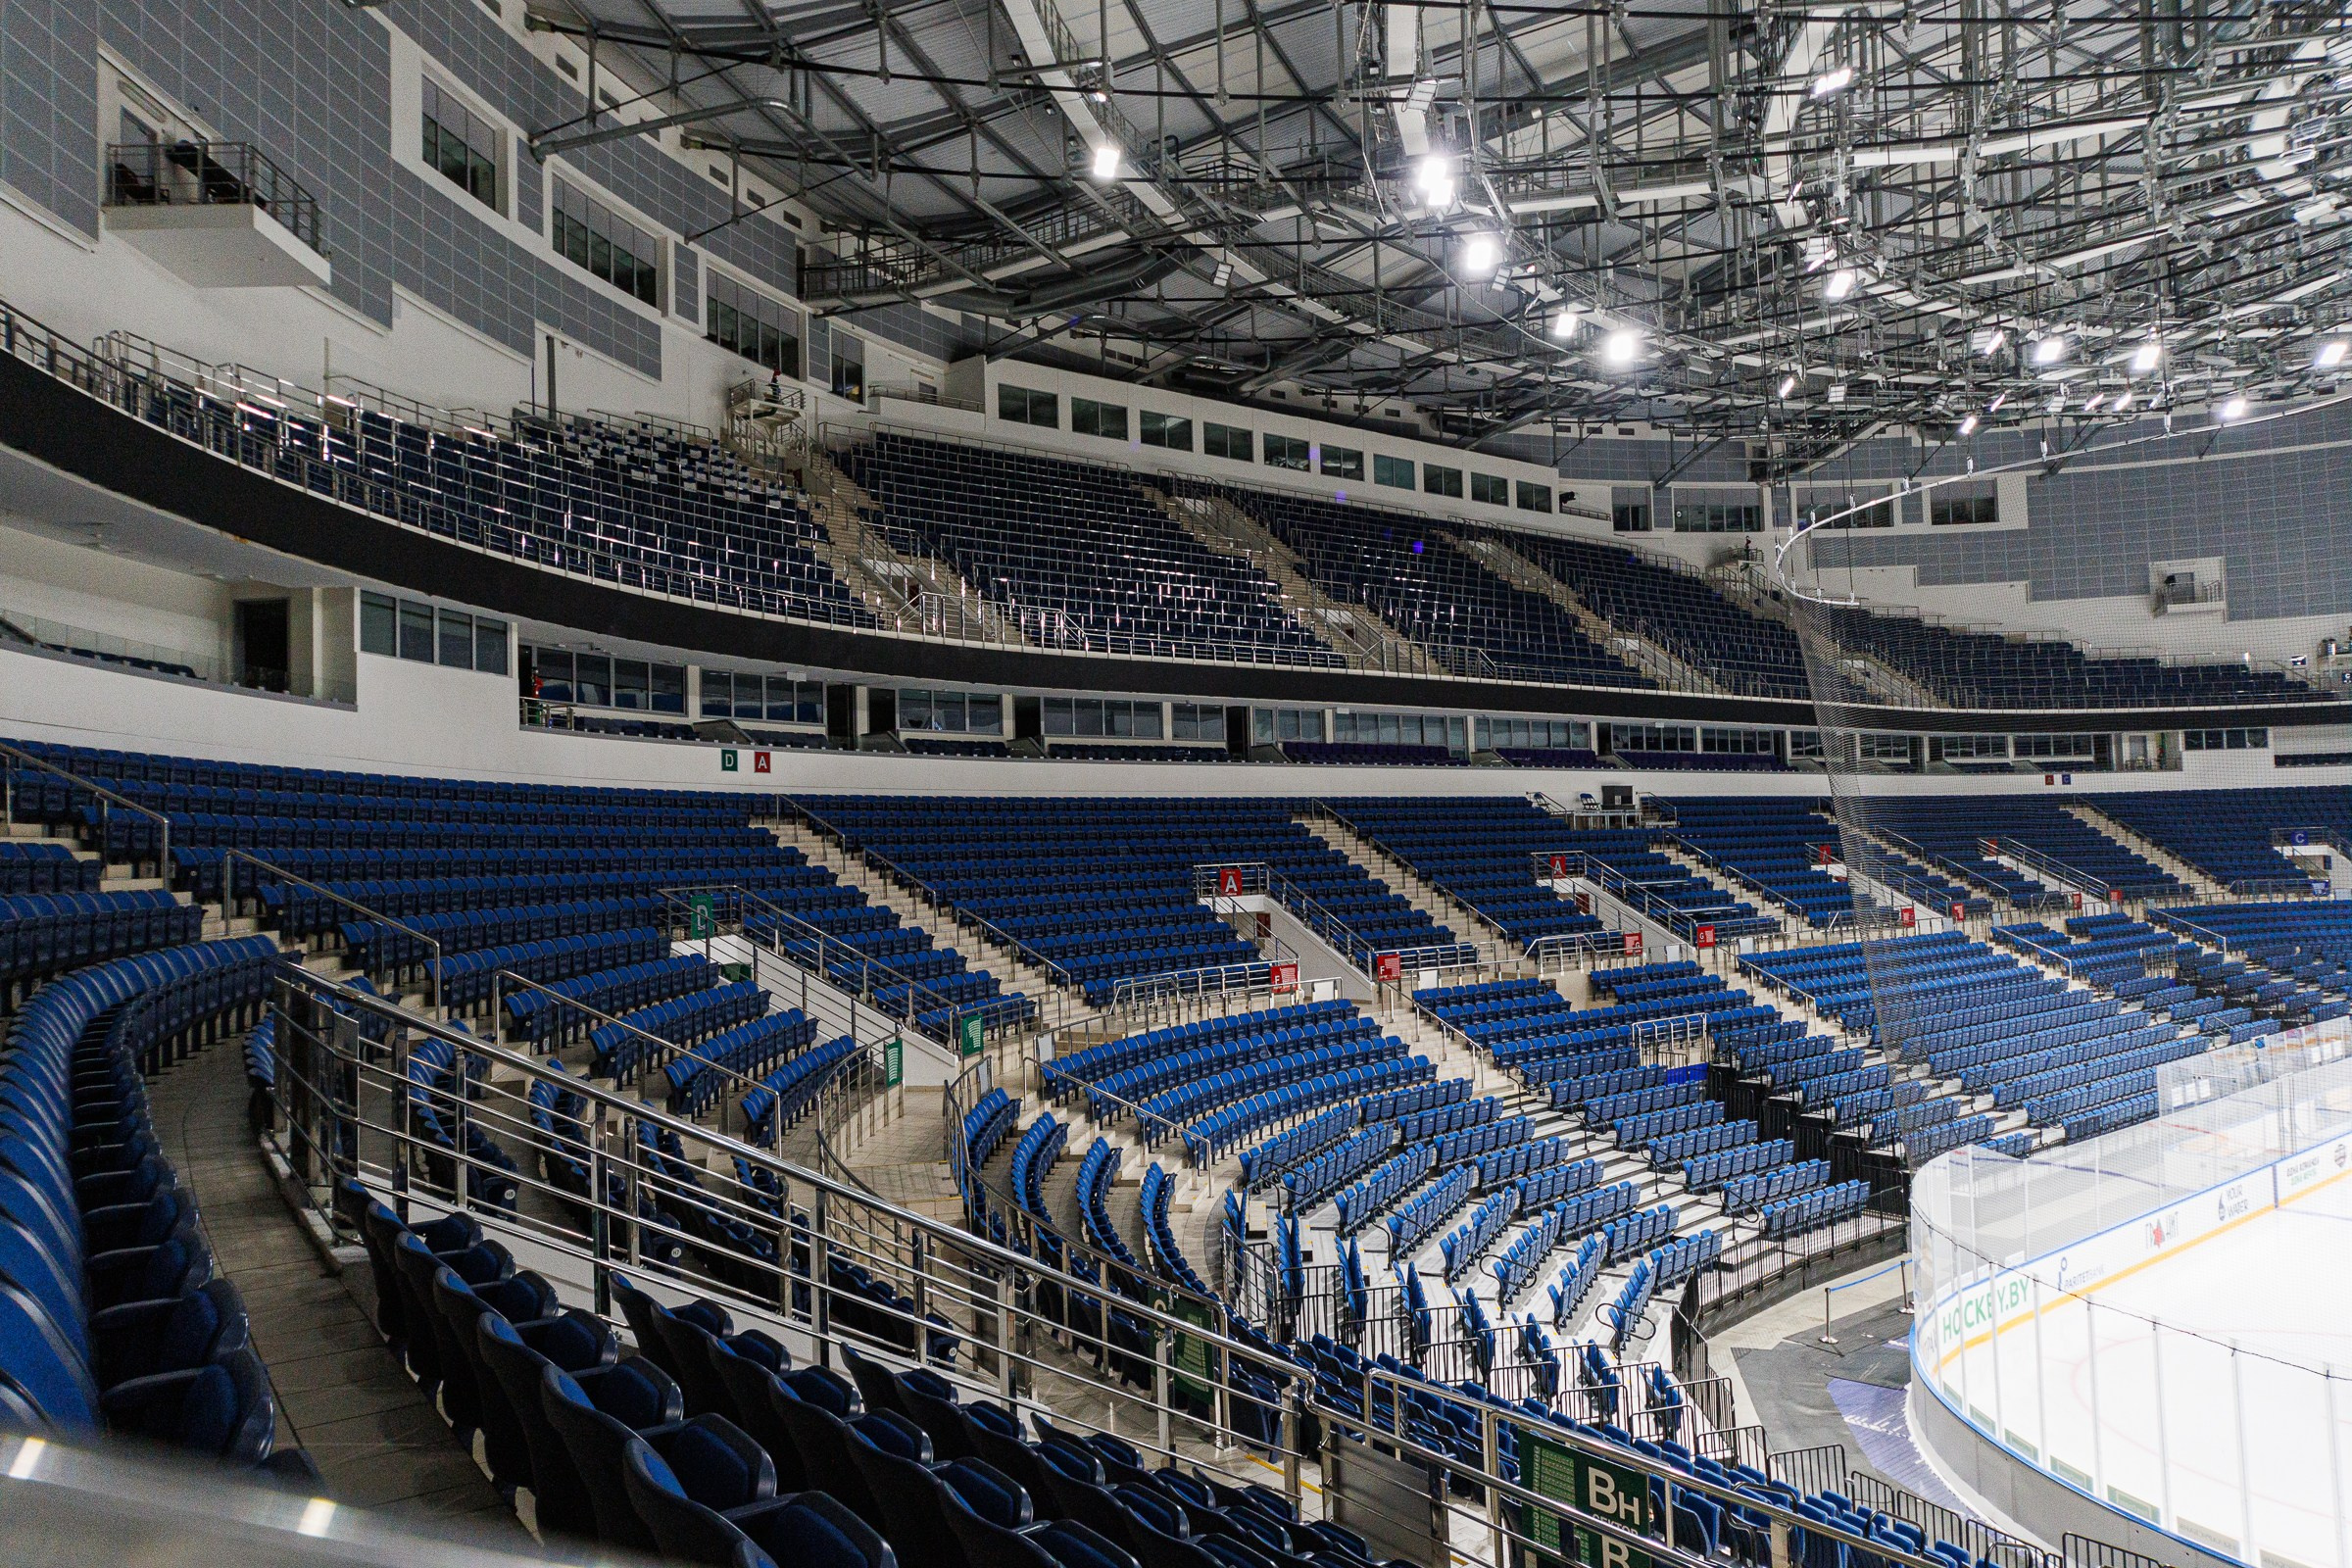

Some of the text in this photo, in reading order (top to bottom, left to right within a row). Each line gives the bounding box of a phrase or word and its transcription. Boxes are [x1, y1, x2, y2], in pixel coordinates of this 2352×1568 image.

[725, 753, 735, 767] D
[758, 755, 768, 769] A
[2295, 833, 2305, 844] C
[1553, 859, 1563, 875] A
[1225, 875, 1238, 893] A
[1942, 1277, 2031, 1344] HOCKEY.BY
